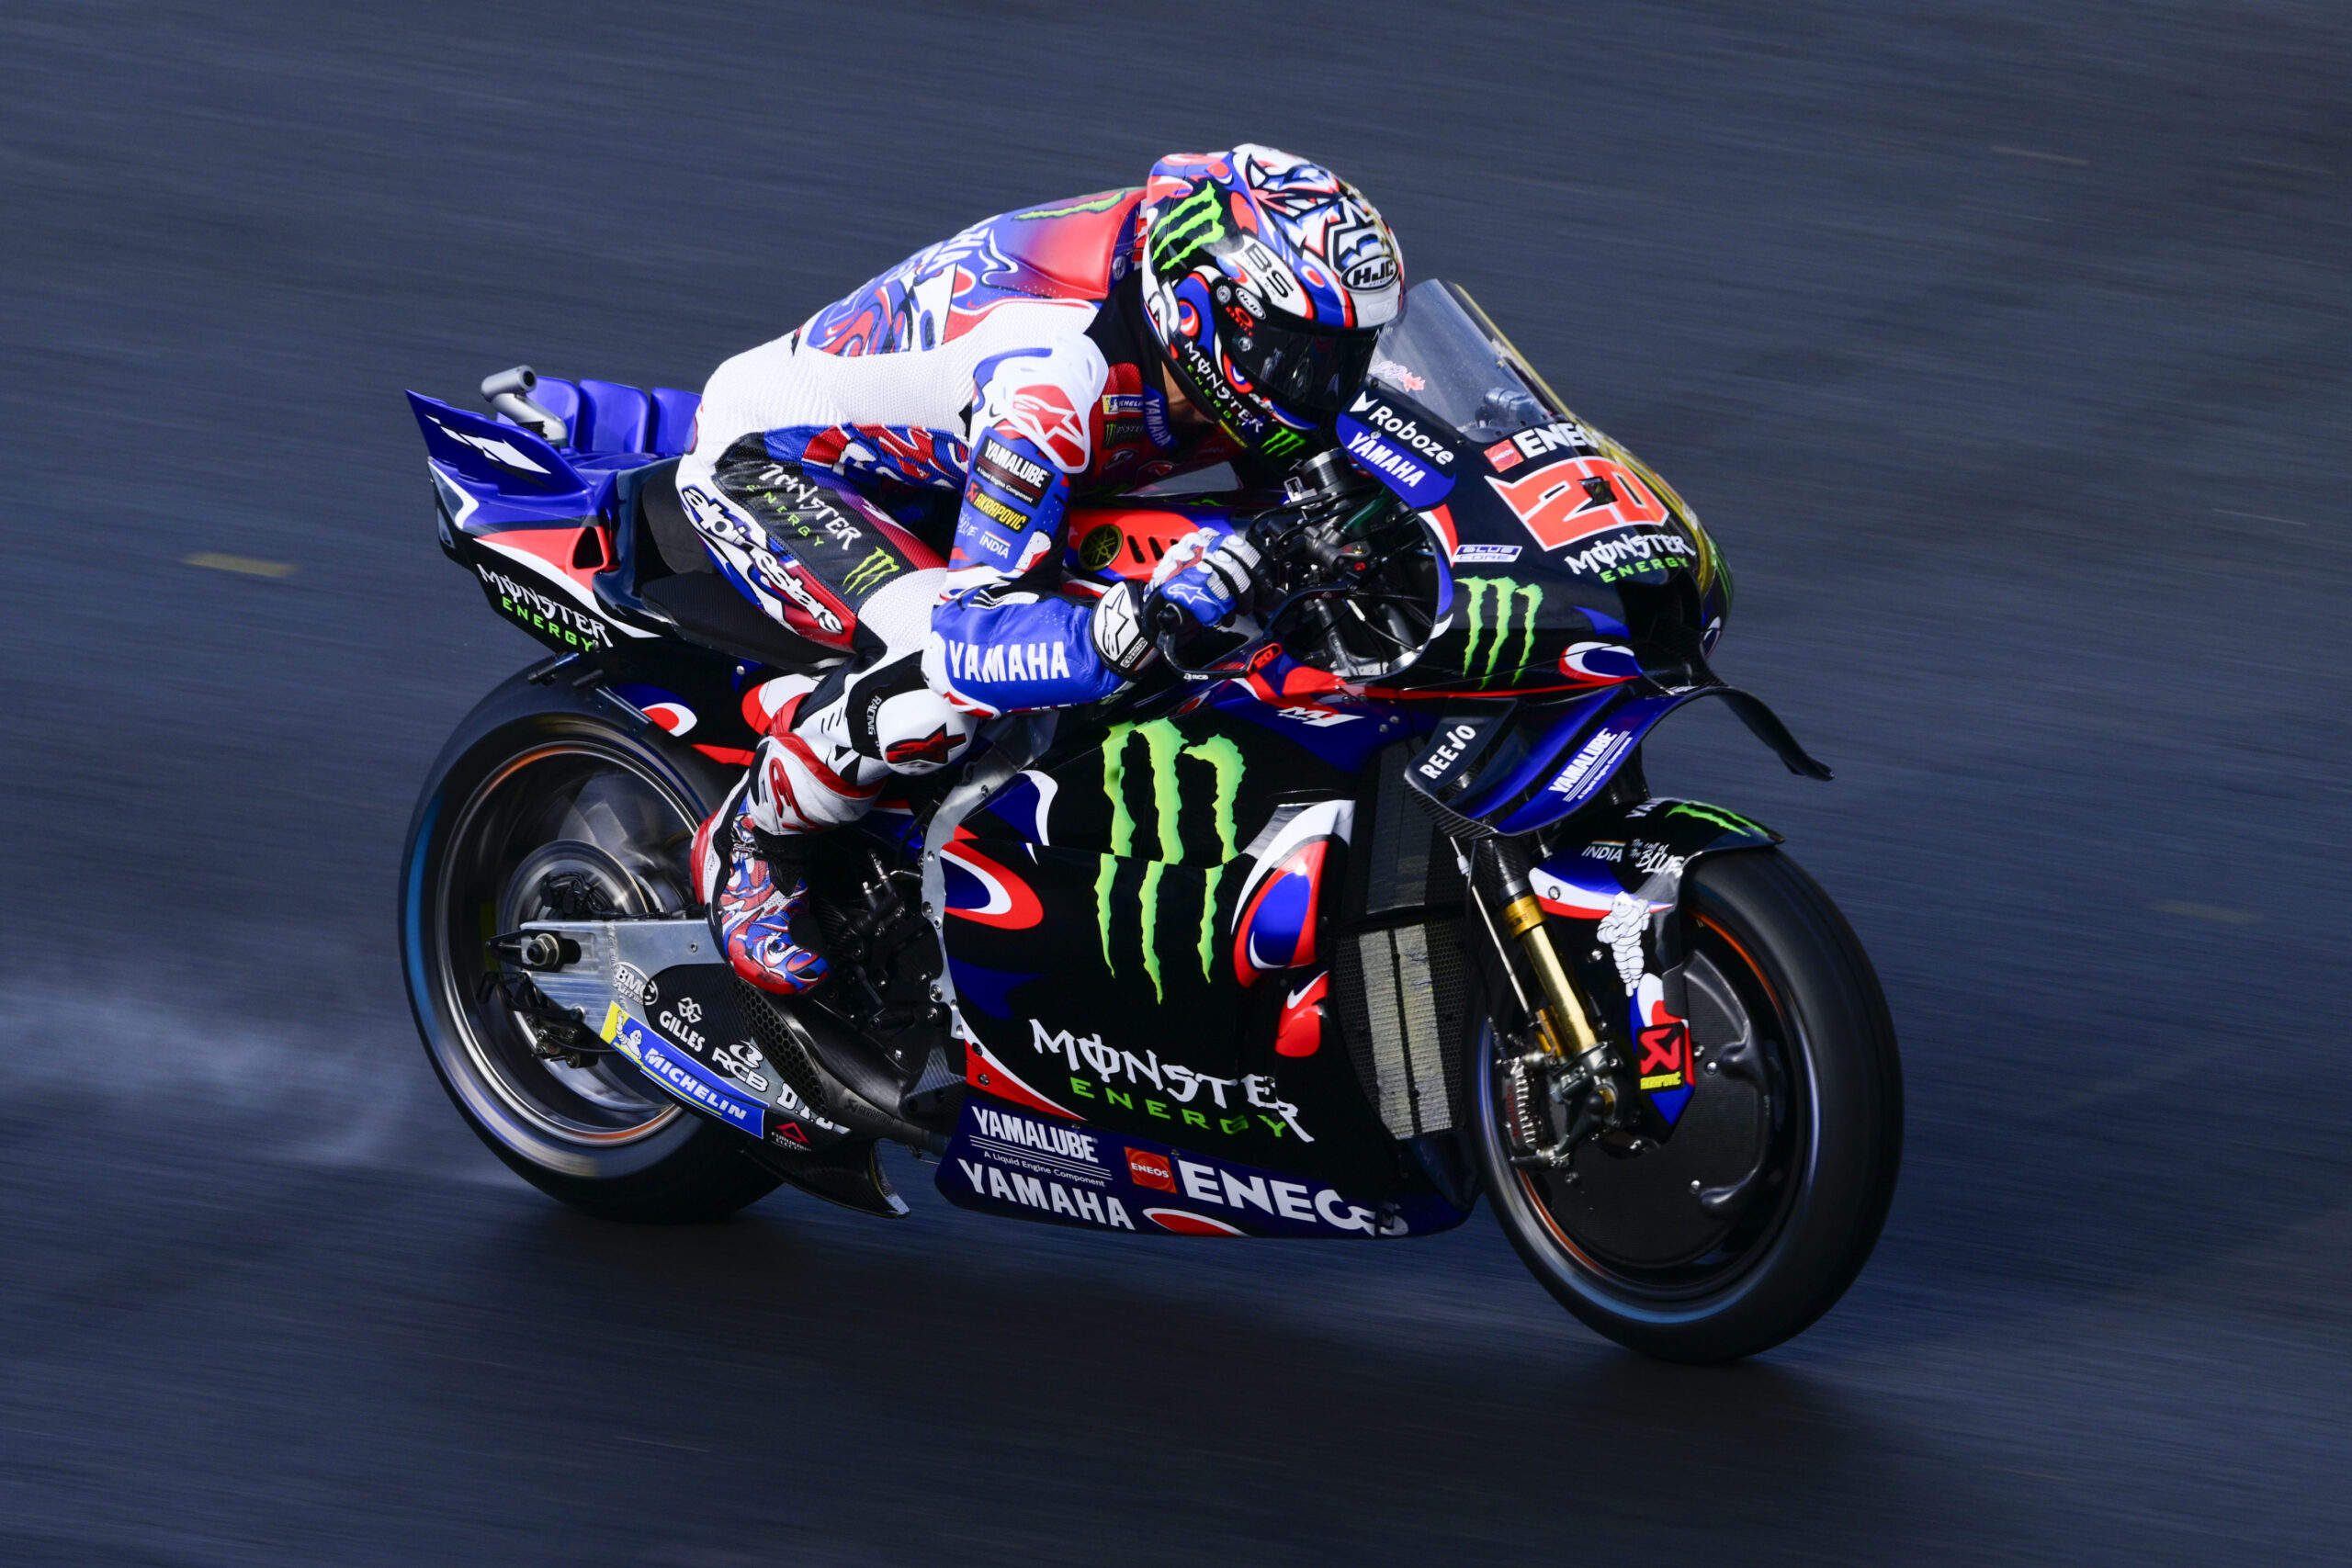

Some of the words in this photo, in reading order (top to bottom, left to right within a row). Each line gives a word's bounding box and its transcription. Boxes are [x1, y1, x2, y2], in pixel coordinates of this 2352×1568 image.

[1352, 261, 1395, 288] HJC
[1145, 399, 1172, 446] YAMAHA
[1367, 404, 1454, 466] Roboze
[1512, 423, 1600, 458] ENEO
[985, 439, 1047, 489] YAMALUBE
[1346, 432, 1427, 488] YAMAHA
[1484, 456, 1670, 552] 20
[682, 488, 843, 634] alpinestars
[978, 535, 1010, 559] INDIA
[1564, 534, 1696, 576] MONSTER
[1600, 557, 1690, 583] ENERGY
[476, 563, 614, 648] MONSTER
[503, 596, 594, 652] ENERGY
[949, 640, 1071, 682] YAMAHA
[866, 694, 882, 736] RACING
[1419, 724, 1476, 780] REEVO
[1548, 728, 1618, 794] YAMALUBE
[1581, 845, 1623, 863] INDIA
[1634, 850, 1686, 877] BLUE
[616, 966, 655, 1000] BMC
[659, 1010, 706, 1053] GILLES
[645, 1047, 747, 1121] MICHELIN
[711, 1047, 769, 1092] RCB
[1029, 1018, 1315, 1143] MONSTER
[1070, 1076, 1286, 1139] ENERGY
[971, 1105, 1099, 1163] YAMALUBE
[993, 1152, 1020, 1167] Liquid
[1022, 1160, 1051, 1174] Engine
[1053, 1168, 1105, 1187] Component
[1130, 1160, 1170, 1179] ENEOS
[956, 1157, 1136, 1231] YAMAHA
